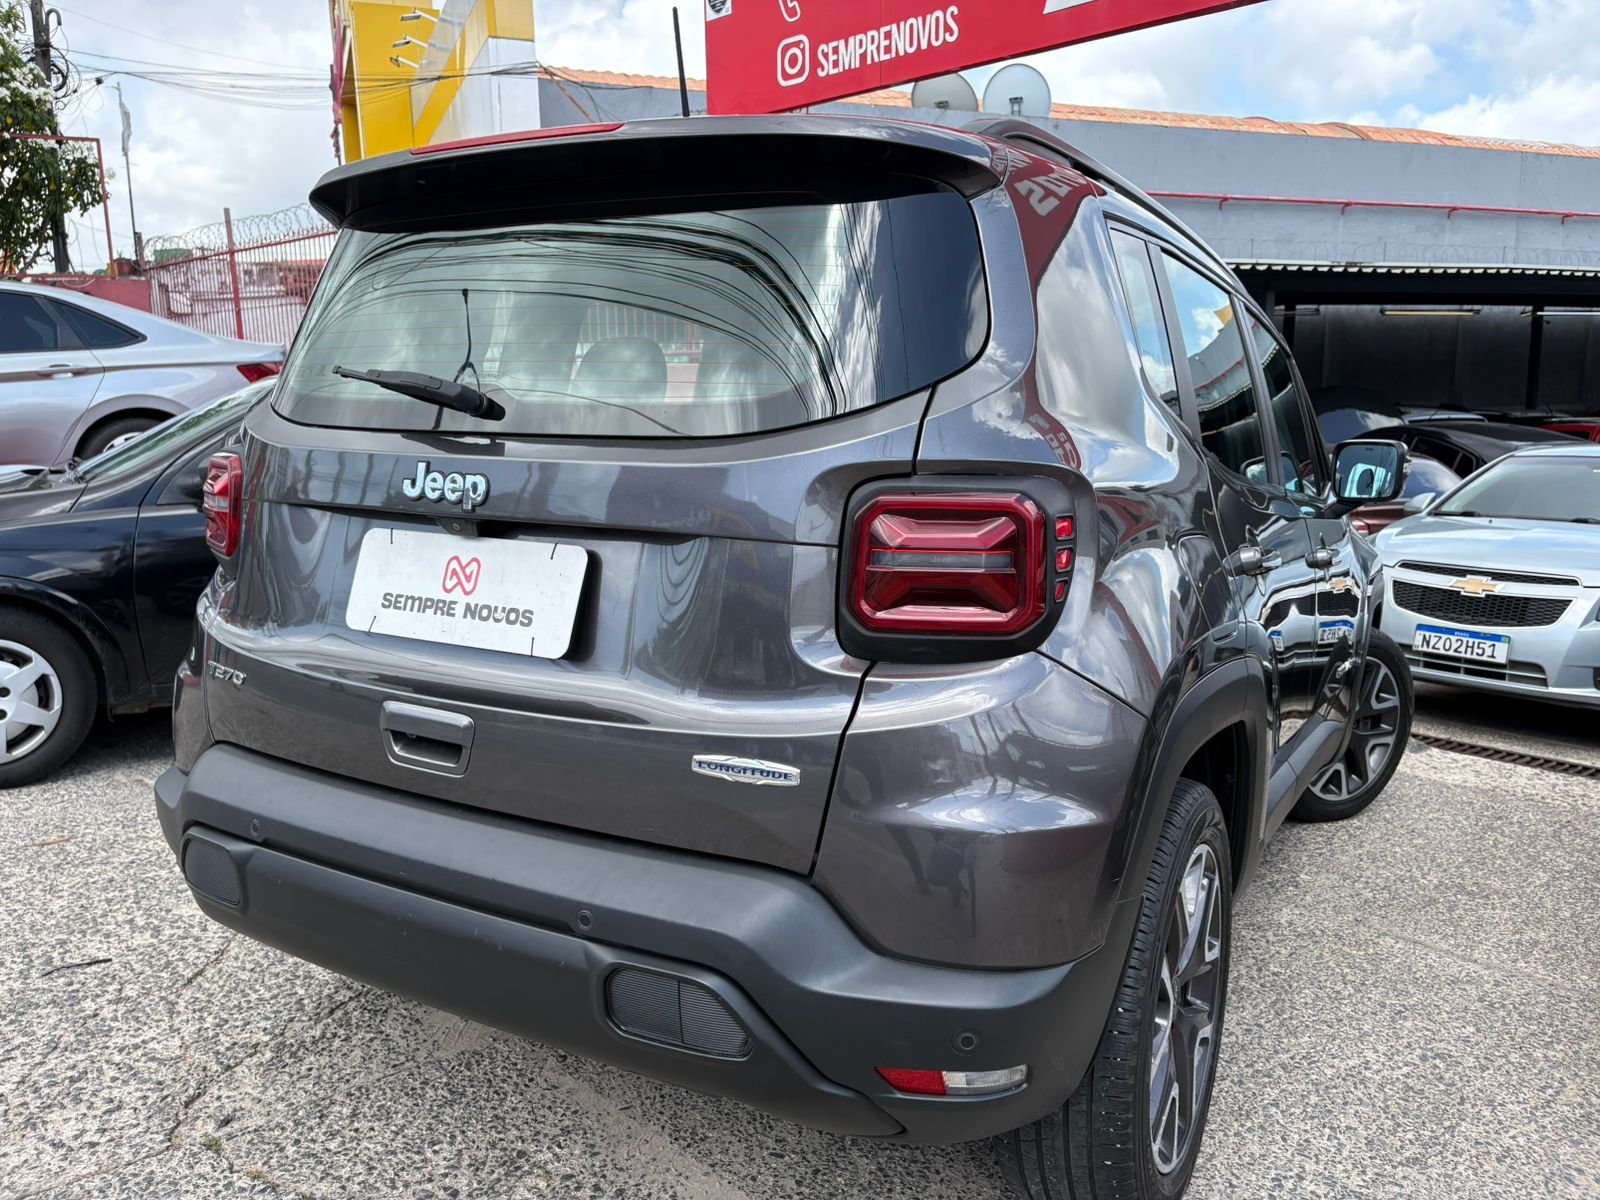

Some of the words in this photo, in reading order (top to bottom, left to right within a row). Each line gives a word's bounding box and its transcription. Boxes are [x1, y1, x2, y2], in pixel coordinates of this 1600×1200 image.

[817, 5, 959, 78] SEMPRENOVOS
[402, 461, 488, 512] Jeep
[381, 592, 458, 618] SEMPRE
[695, 760, 794, 782] LONGITUDE
